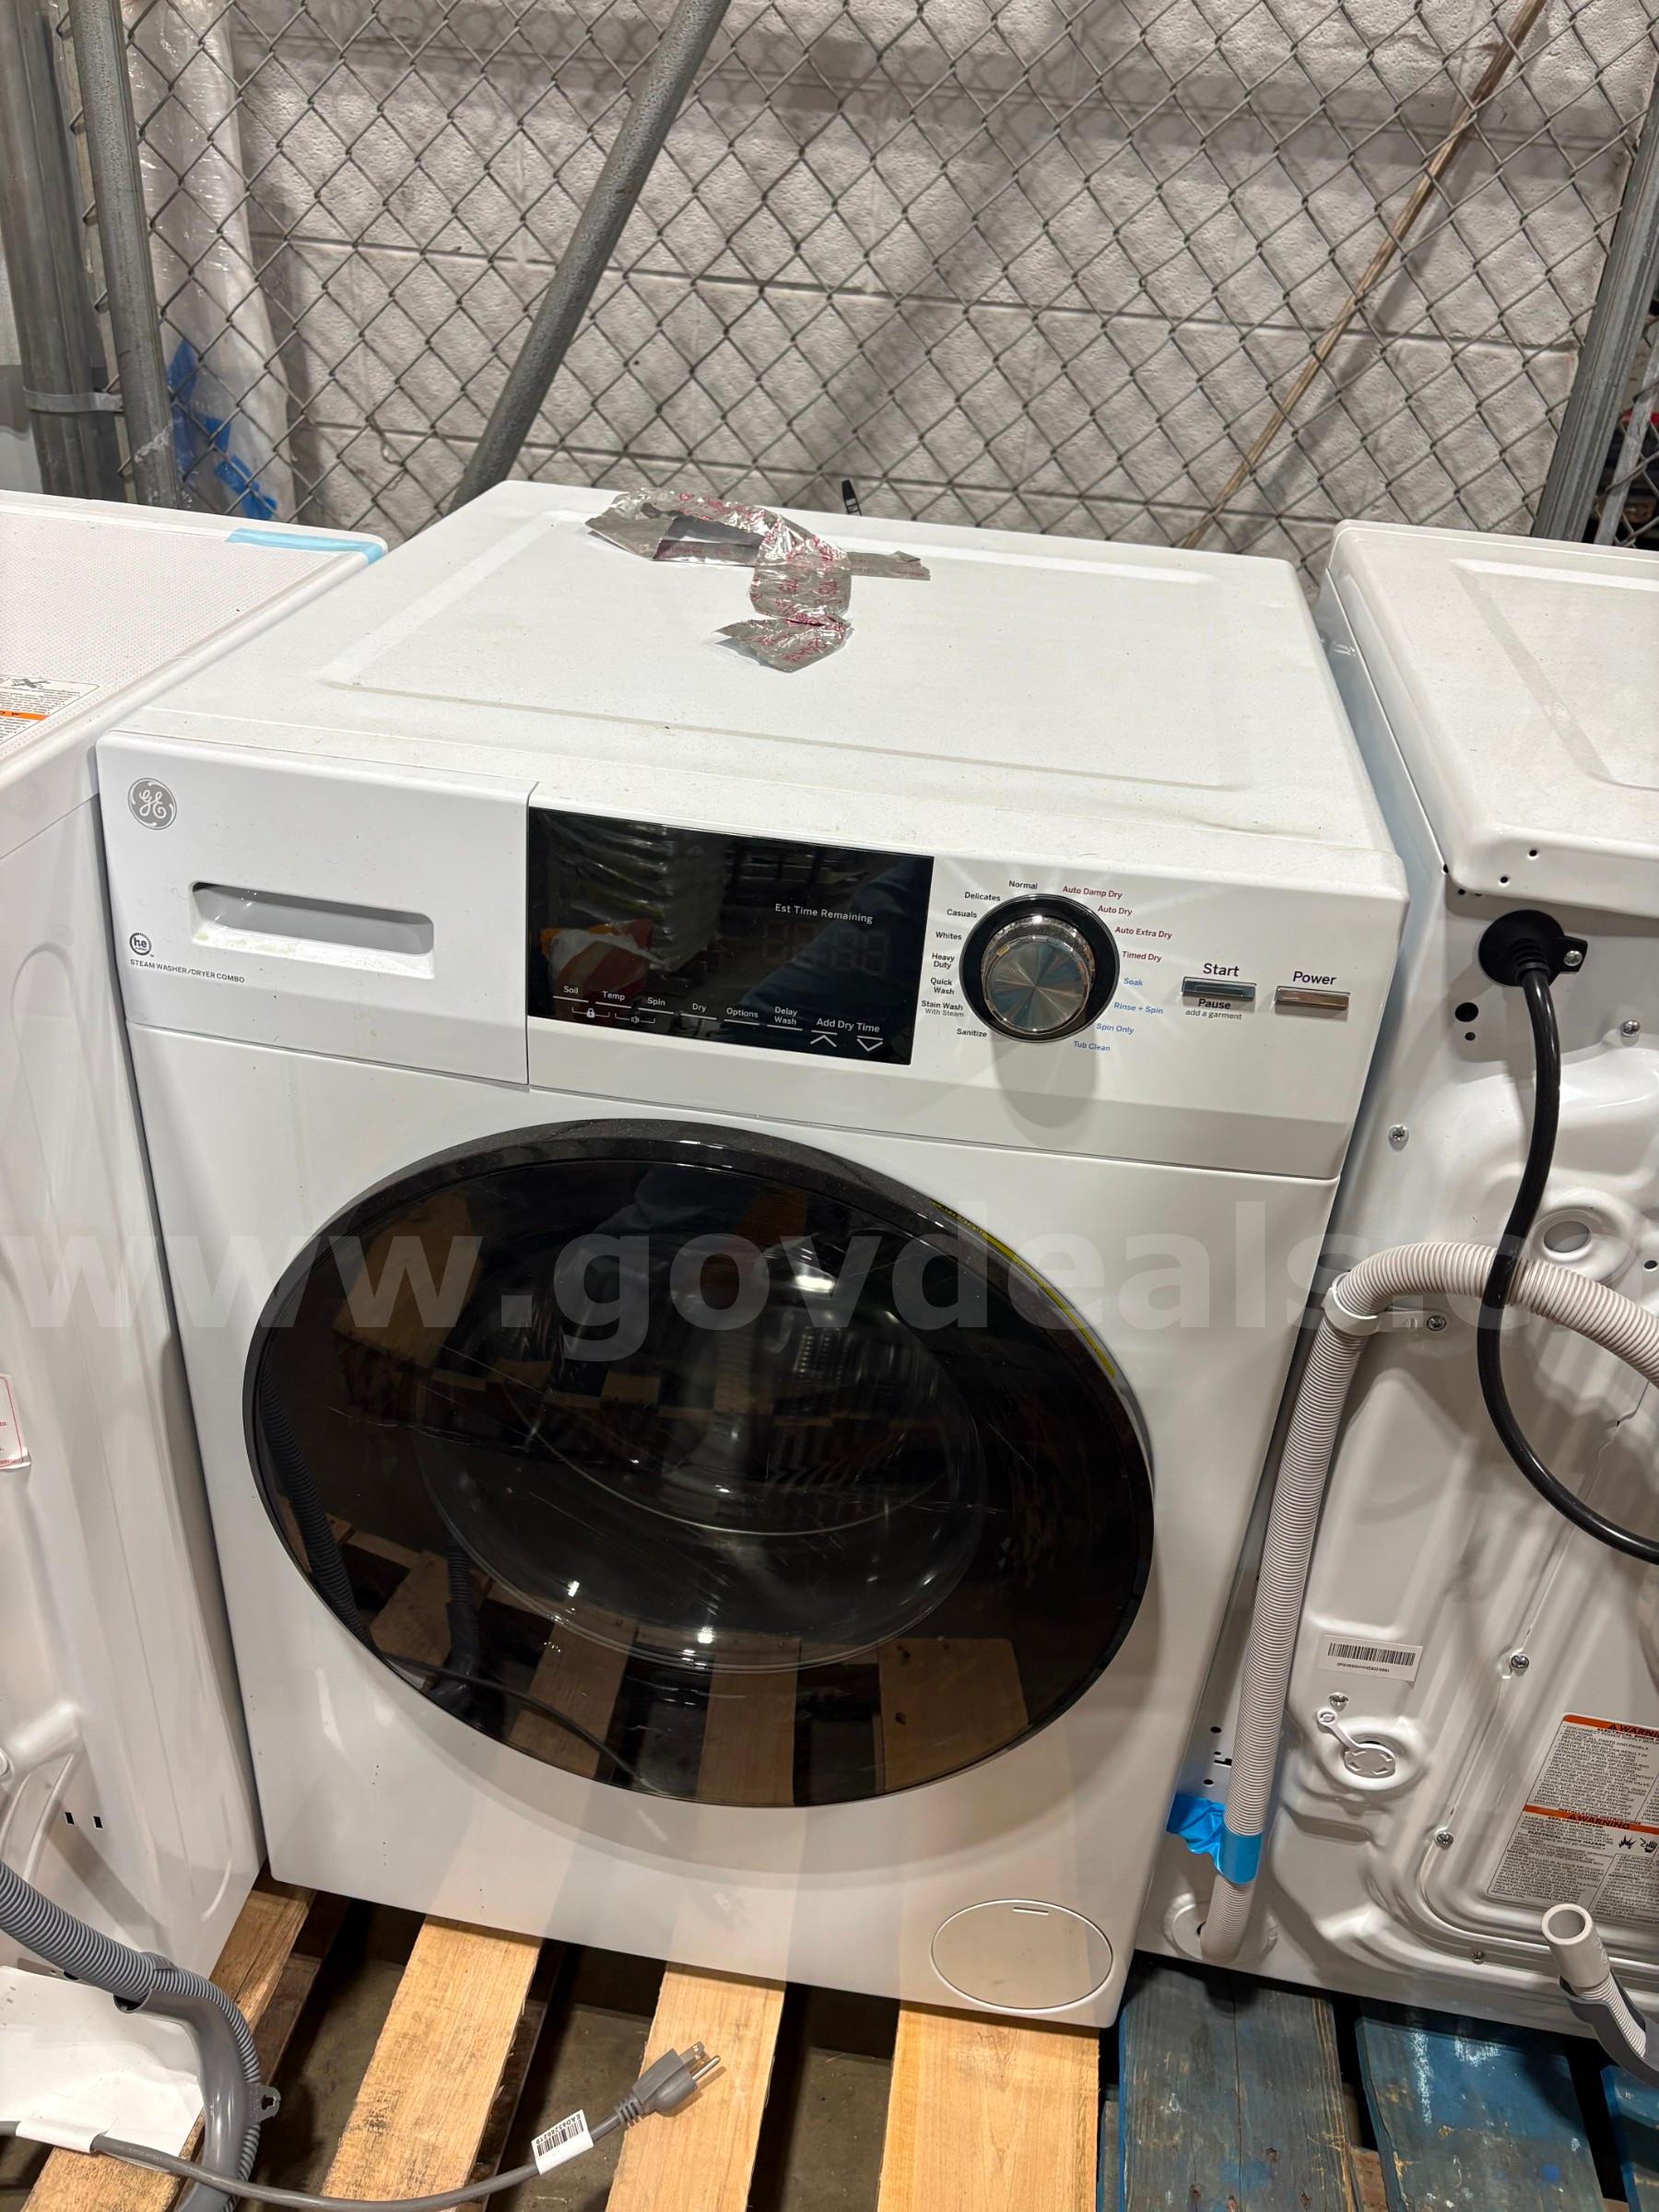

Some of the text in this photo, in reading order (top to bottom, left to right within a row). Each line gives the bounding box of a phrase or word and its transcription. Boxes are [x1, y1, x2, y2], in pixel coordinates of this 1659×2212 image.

[1008, 880, 1038, 889] Normal
[964, 891, 1001, 901] Delicates
[1062, 886, 1123, 900] Auto Damp Dry
[775, 903, 873, 924] Est Time Remaining
[947, 909, 978, 918] Casuals
[1098, 905, 1133, 916] Auto Dry
[935, 931, 962, 940] Whites
[1114, 926, 1172, 940] Auto Extra Dry
[932, 953, 955, 961] Heavy
[1122, 950, 1162, 962] Timed Dry
[130, 959, 155, 969] STEAM
[217, 972, 245, 983] COMBO
[933, 960, 952, 971] Duty
[1203, 962, 1240, 977] Start
[930, 977, 952, 985] Quick
[1123, 978, 1143, 986] Soak
[1292, 971, 1337, 985] Power
[563, 985, 579, 994] Soil
[602, 991, 625, 1001] Temp
[647, 996, 665, 1006] Spin
[692, 1003, 707, 1013] Dry
[922, 1000, 963, 1011] Stain Wash
[1113, 1002, 1136, 1011] Rinse
[1145, 1006, 1164, 1015] Spin
[1198, 998, 1231, 1010] Pause
[726, 1007, 759, 1018] Options
[774, 1006, 797, 1017] Delay
[1207, 1011, 1242, 1020] garment
[774, 1016, 797, 1026] Wash
[817, 1018, 880, 1032] Add Dry Time
[956, 1028, 987, 1038] Sanitize
[1096, 1023, 1135, 1035] Spin Only
[1074, 1041, 1111, 1052] Tub Clean
[1577, 1815, 1630, 1830] WARNING
